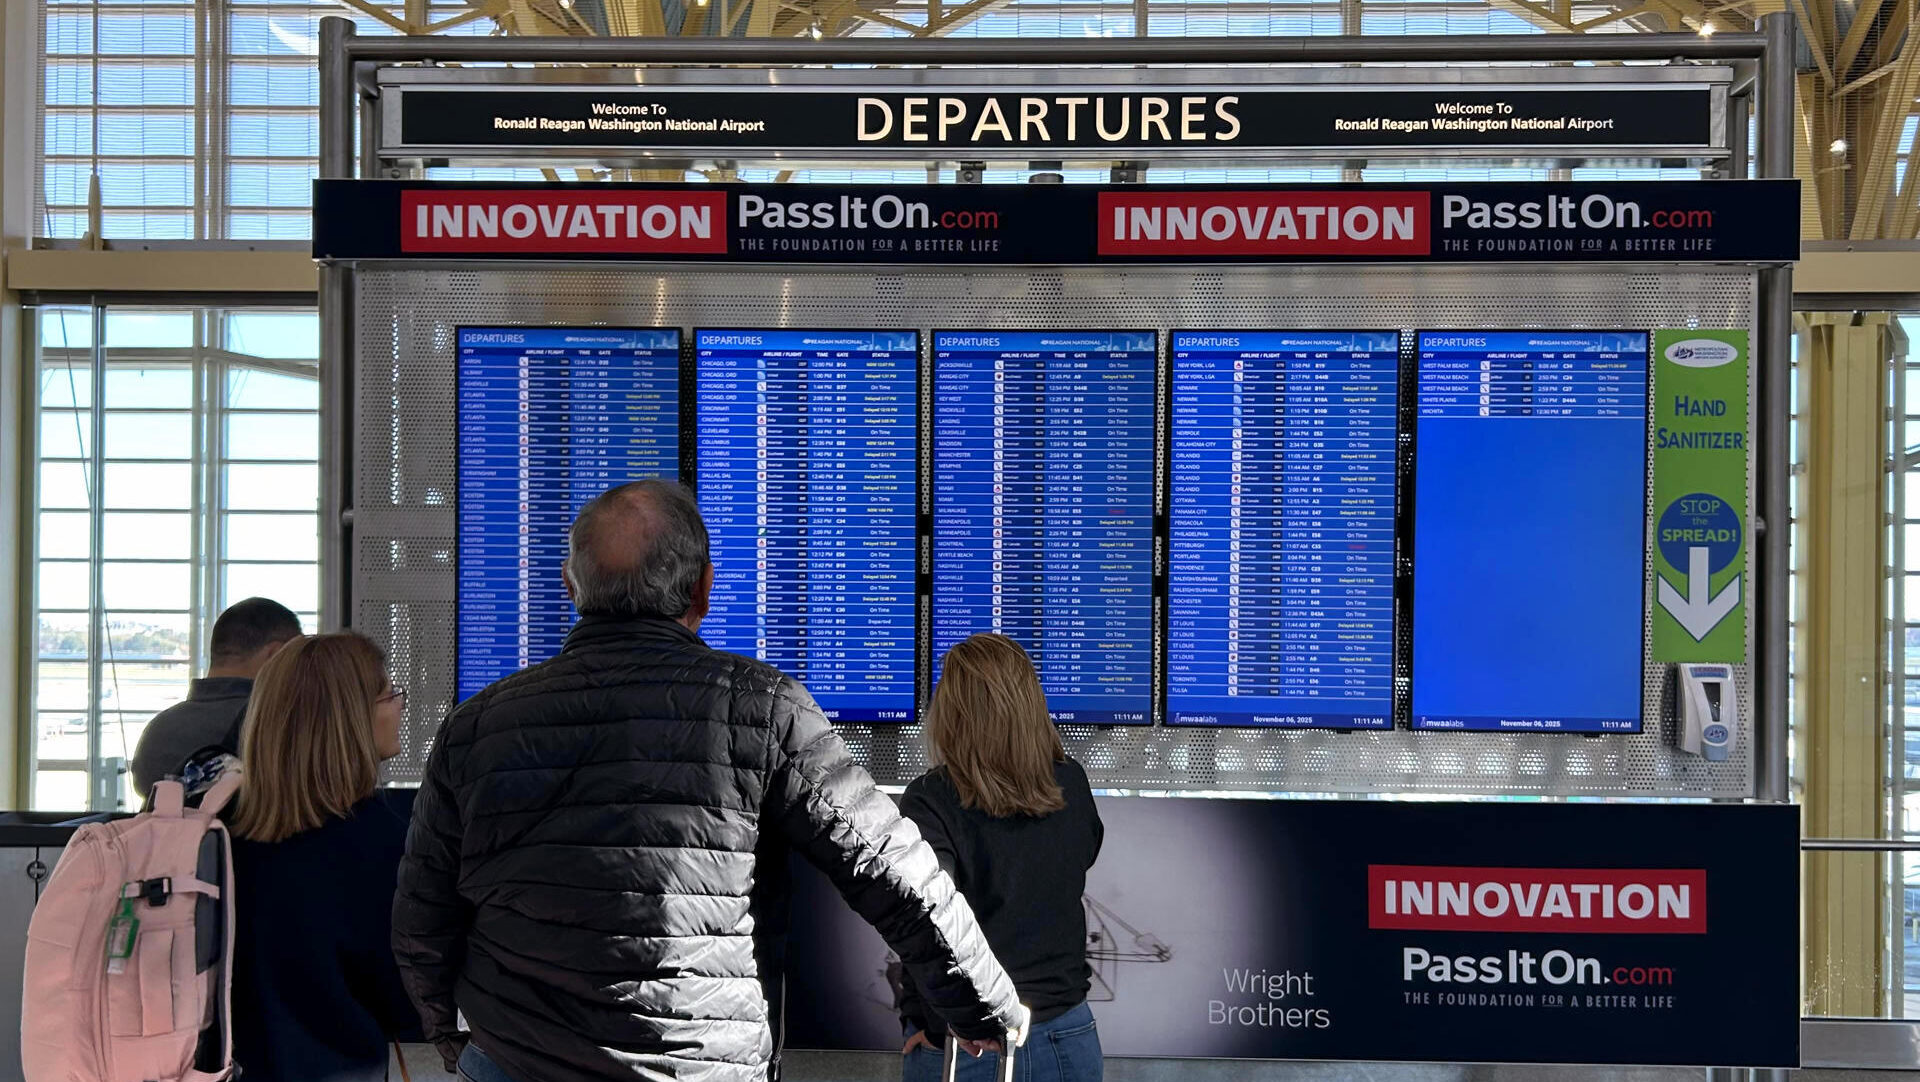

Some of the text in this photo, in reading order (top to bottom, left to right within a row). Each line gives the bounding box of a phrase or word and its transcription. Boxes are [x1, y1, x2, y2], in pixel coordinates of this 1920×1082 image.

[592, 103, 666, 115] Welcome To
[1435, 103, 1512, 114] Welcome To
[494, 117, 764, 133] Ronald Reagan Washington National Airport
[858, 96, 1240, 141] DEPARTURES
[1336, 118, 1613, 132] Ronald Reagan Washington National Airport
[418, 204, 710, 238] INNOVATION
[1115, 206, 1413, 240] INNOVATION
[740, 239, 998, 251] THE FOUNDATION FOR A BETTER LIFE
[1443, 239, 1712, 251] THE FOUNDATION FOR A BETTER LIFE
[464, 334, 524, 343] DEPARTURES
[702, 336, 762, 345] DEPARTURES
[940, 338, 1000, 346] DEPARTURES
[1179, 338, 1240, 346] DEPARTURES
[1424, 338, 1486, 346] DEPARTURES
[1680, 499, 1720, 514] STOP
[1692, 517, 1708, 525] the
[1663, 529, 1736, 542] SPREAD!
[1386, 881, 1689, 918] INNOVATION
[1222, 966, 1314, 1000] Wright
[1404, 992, 1672, 1008] THE FOUNDATION FOR A BETTER LIFE
[1206, 998, 1330, 1030] Brothers
